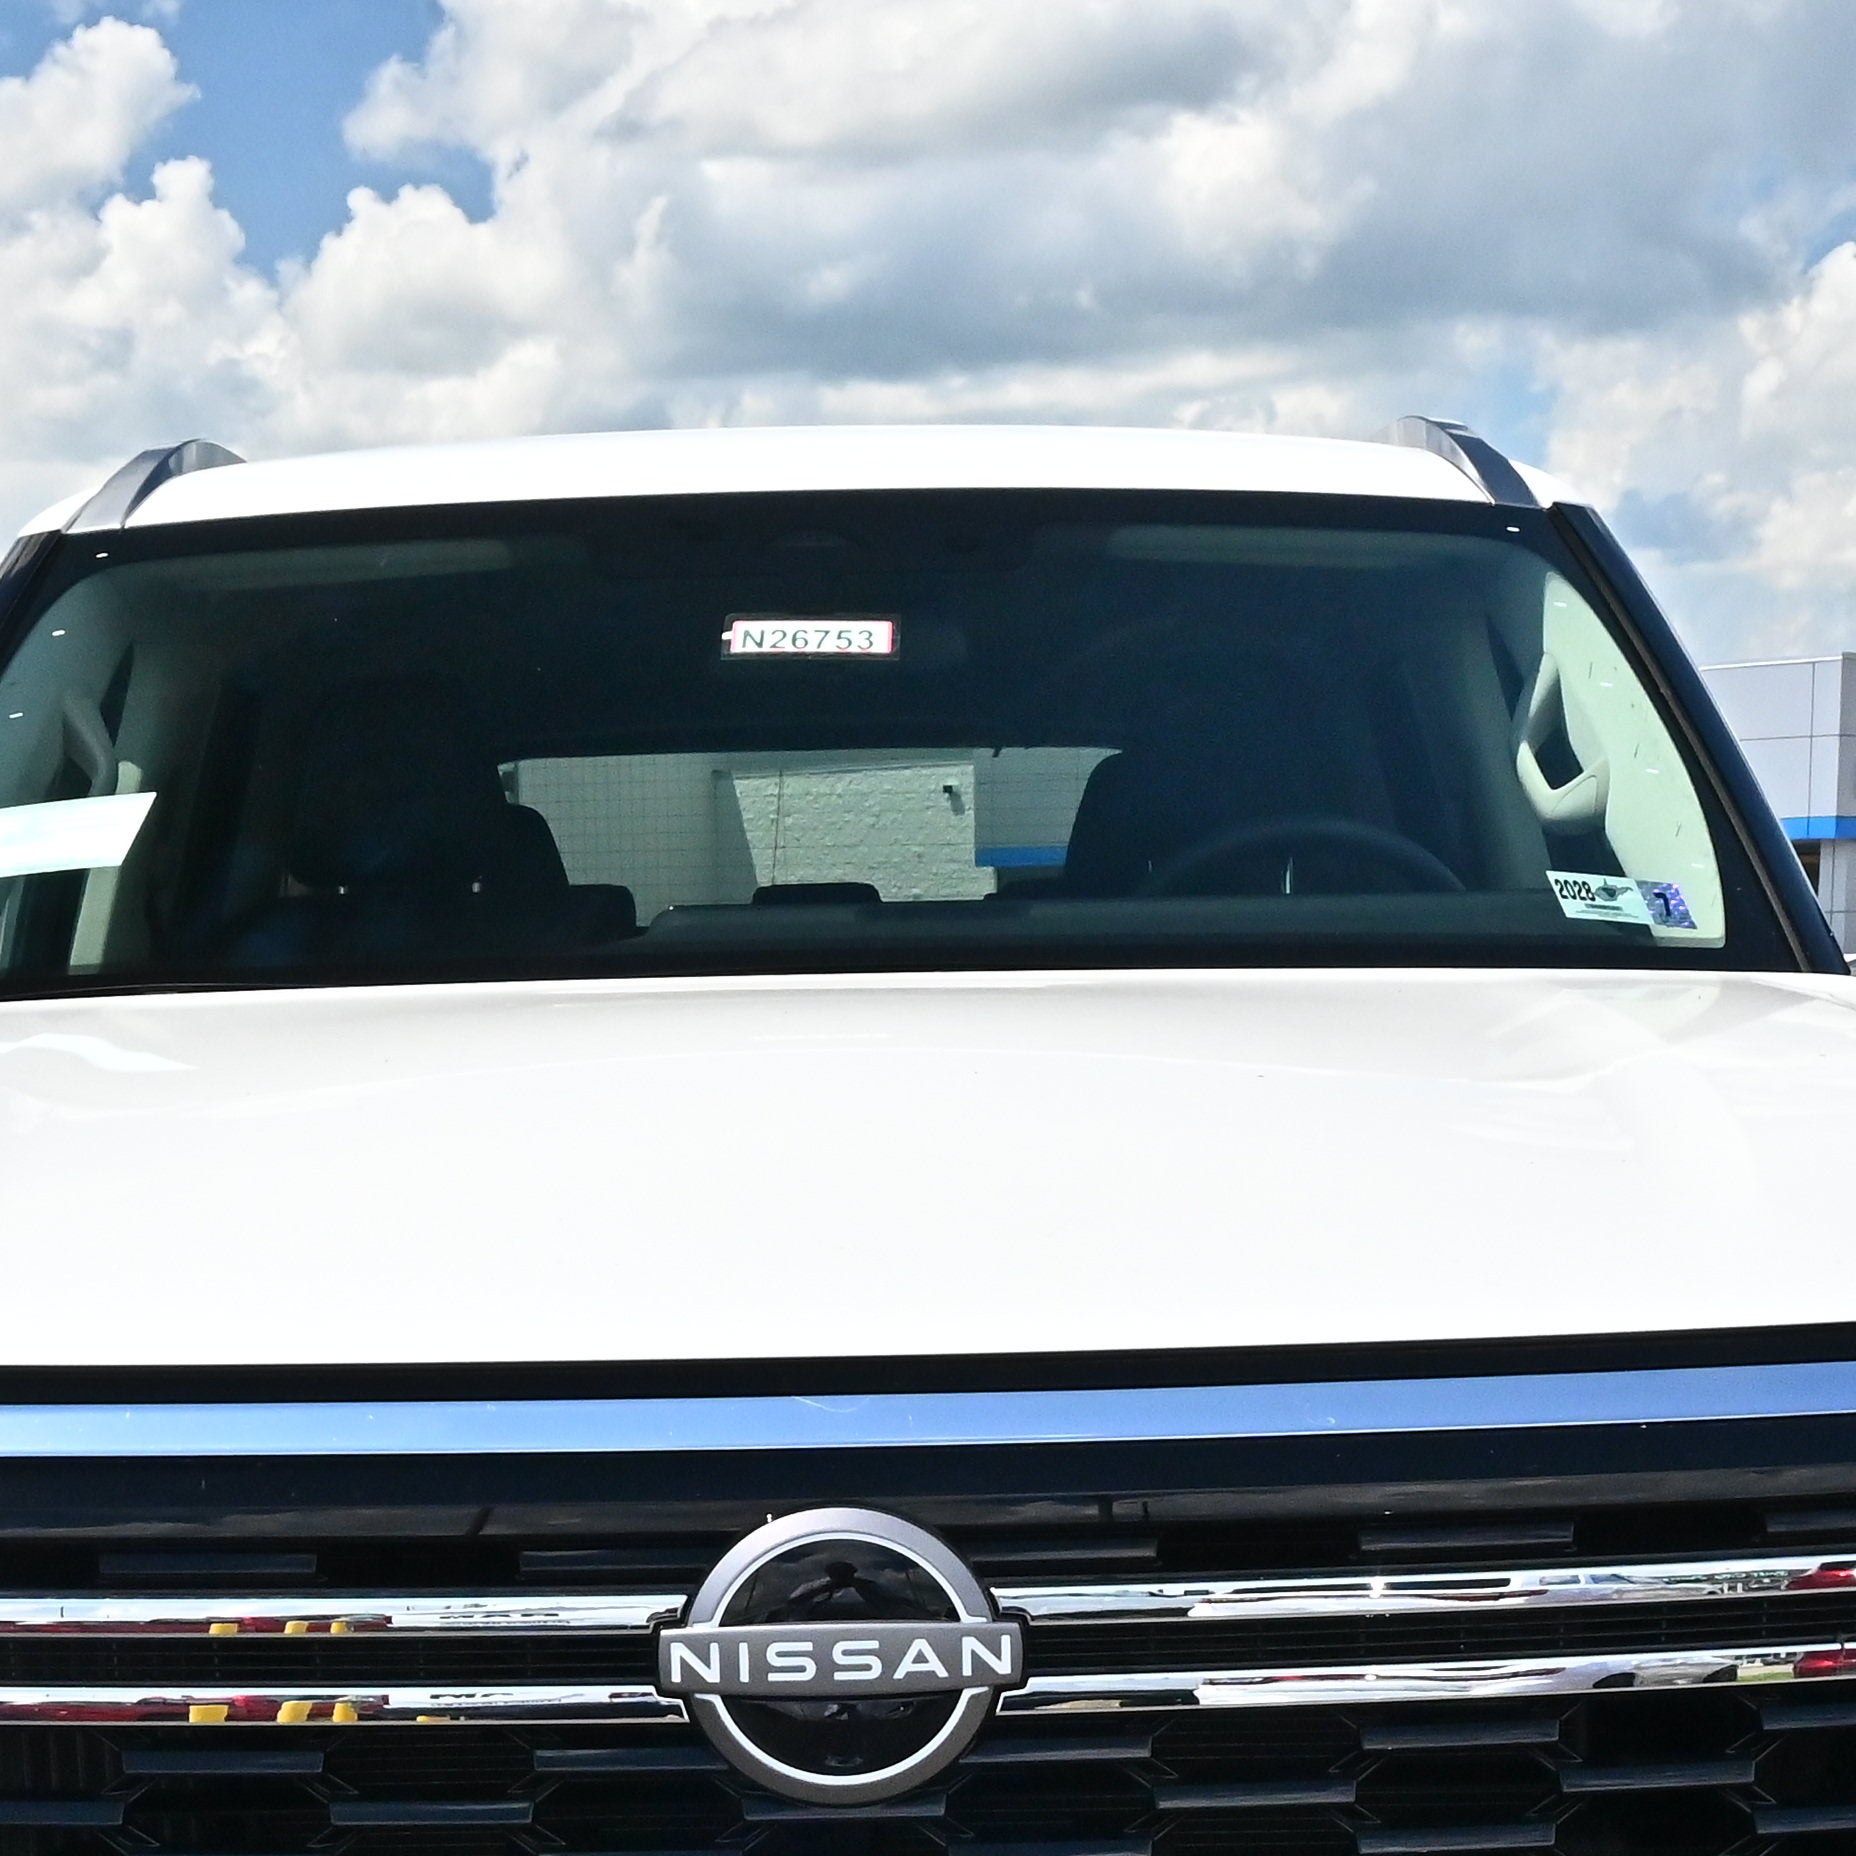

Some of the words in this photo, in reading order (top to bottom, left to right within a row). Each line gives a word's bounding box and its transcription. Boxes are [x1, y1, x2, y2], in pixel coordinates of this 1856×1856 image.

[741, 629, 874, 650] N26753
[1554, 878, 1597, 902] 2028
[669, 1634, 1013, 1684] NISSAN
